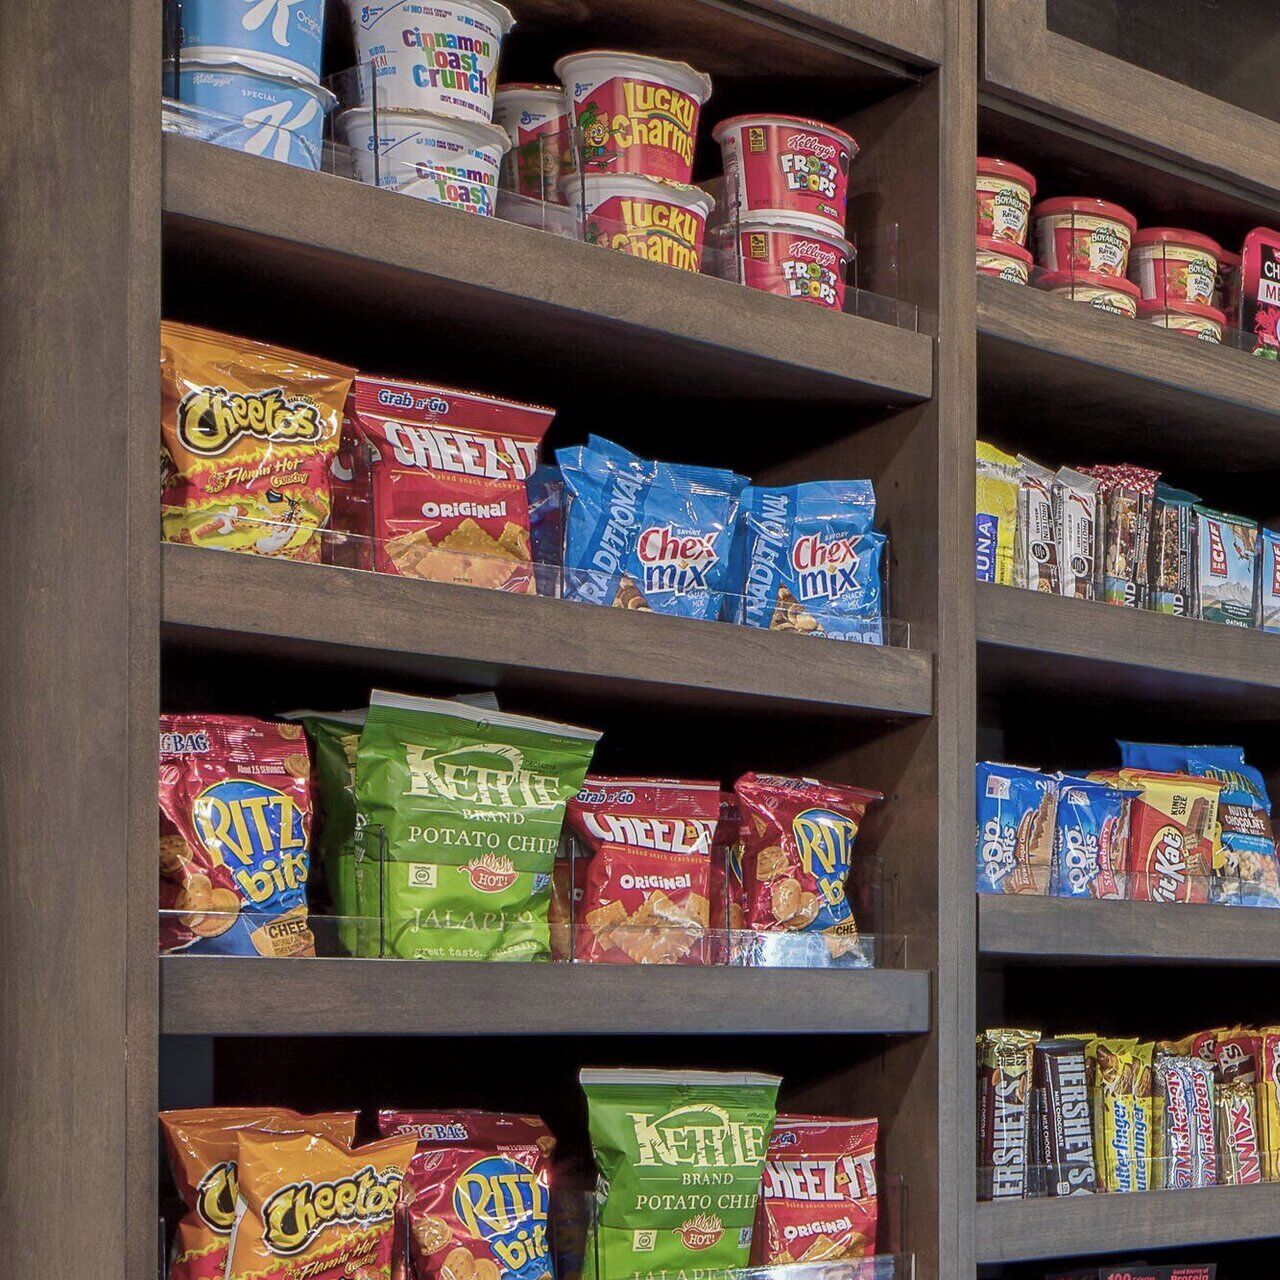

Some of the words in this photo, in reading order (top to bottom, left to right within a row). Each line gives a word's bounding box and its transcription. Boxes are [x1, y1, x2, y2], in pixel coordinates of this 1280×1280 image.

[402, 26, 490, 57] Cinnamon
[424, 47, 481, 74] Toast
[412, 63, 490, 97] Crunch
[241, 89, 278, 103] SPECIAL
[378, 389, 412, 409] Grab
[179, 386, 321, 455] Cheetos
[638, 526, 719, 562] Chex
[793, 533, 864, 571] Chex
[195, 796, 304, 867] RITZ
[408, 826, 500, 849] POTATO
[682, 1173, 734, 1187] BRAND
[265, 1172, 400, 1253] Cheetos
[635, 1194, 711, 1211] POTATO
